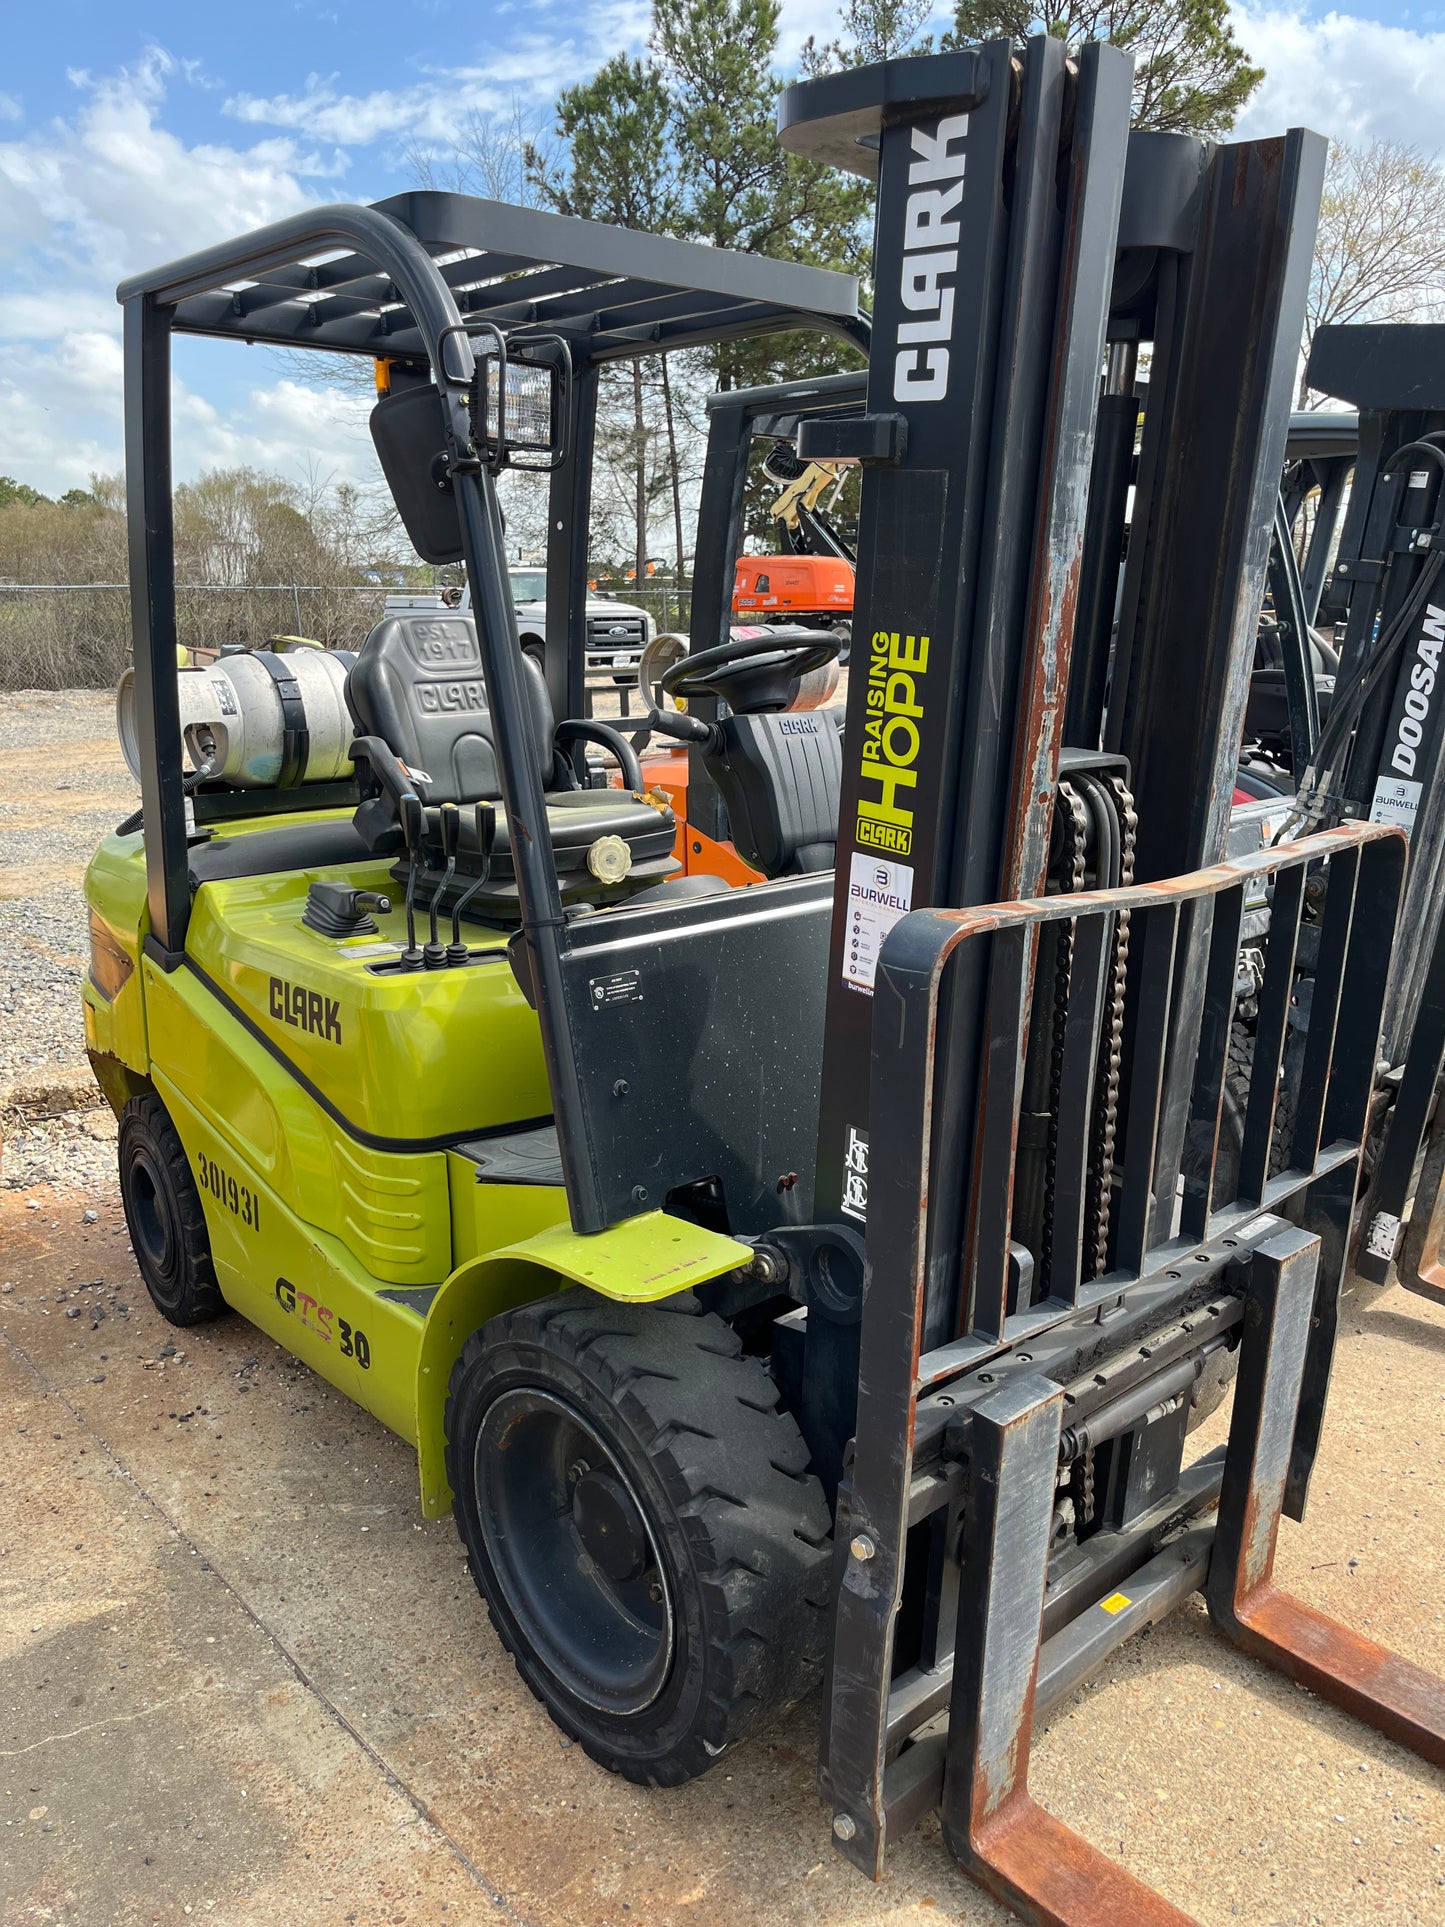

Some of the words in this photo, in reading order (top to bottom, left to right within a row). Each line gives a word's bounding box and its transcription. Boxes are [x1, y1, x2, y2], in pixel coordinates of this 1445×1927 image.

[893, 113, 969, 402] CLARK
[414, 622, 457, 640] est.
[419, 640, 471, 660] 1917
[862, 631, 890, 761] RAISING
[1391, 603, 1445, 777] DOOSAN
[778, 718, 818, 736] CLARK
[857, 632, 930, 828] HOPE
[1375, 795, 1419, 811] BURWELL
[859, 821, 909, 852] CLARK
[850, 884, 909, 912] BURWELL
[269, 975, 342, 1046] CLARK
[198, 1151, 260, 1233] 301931
